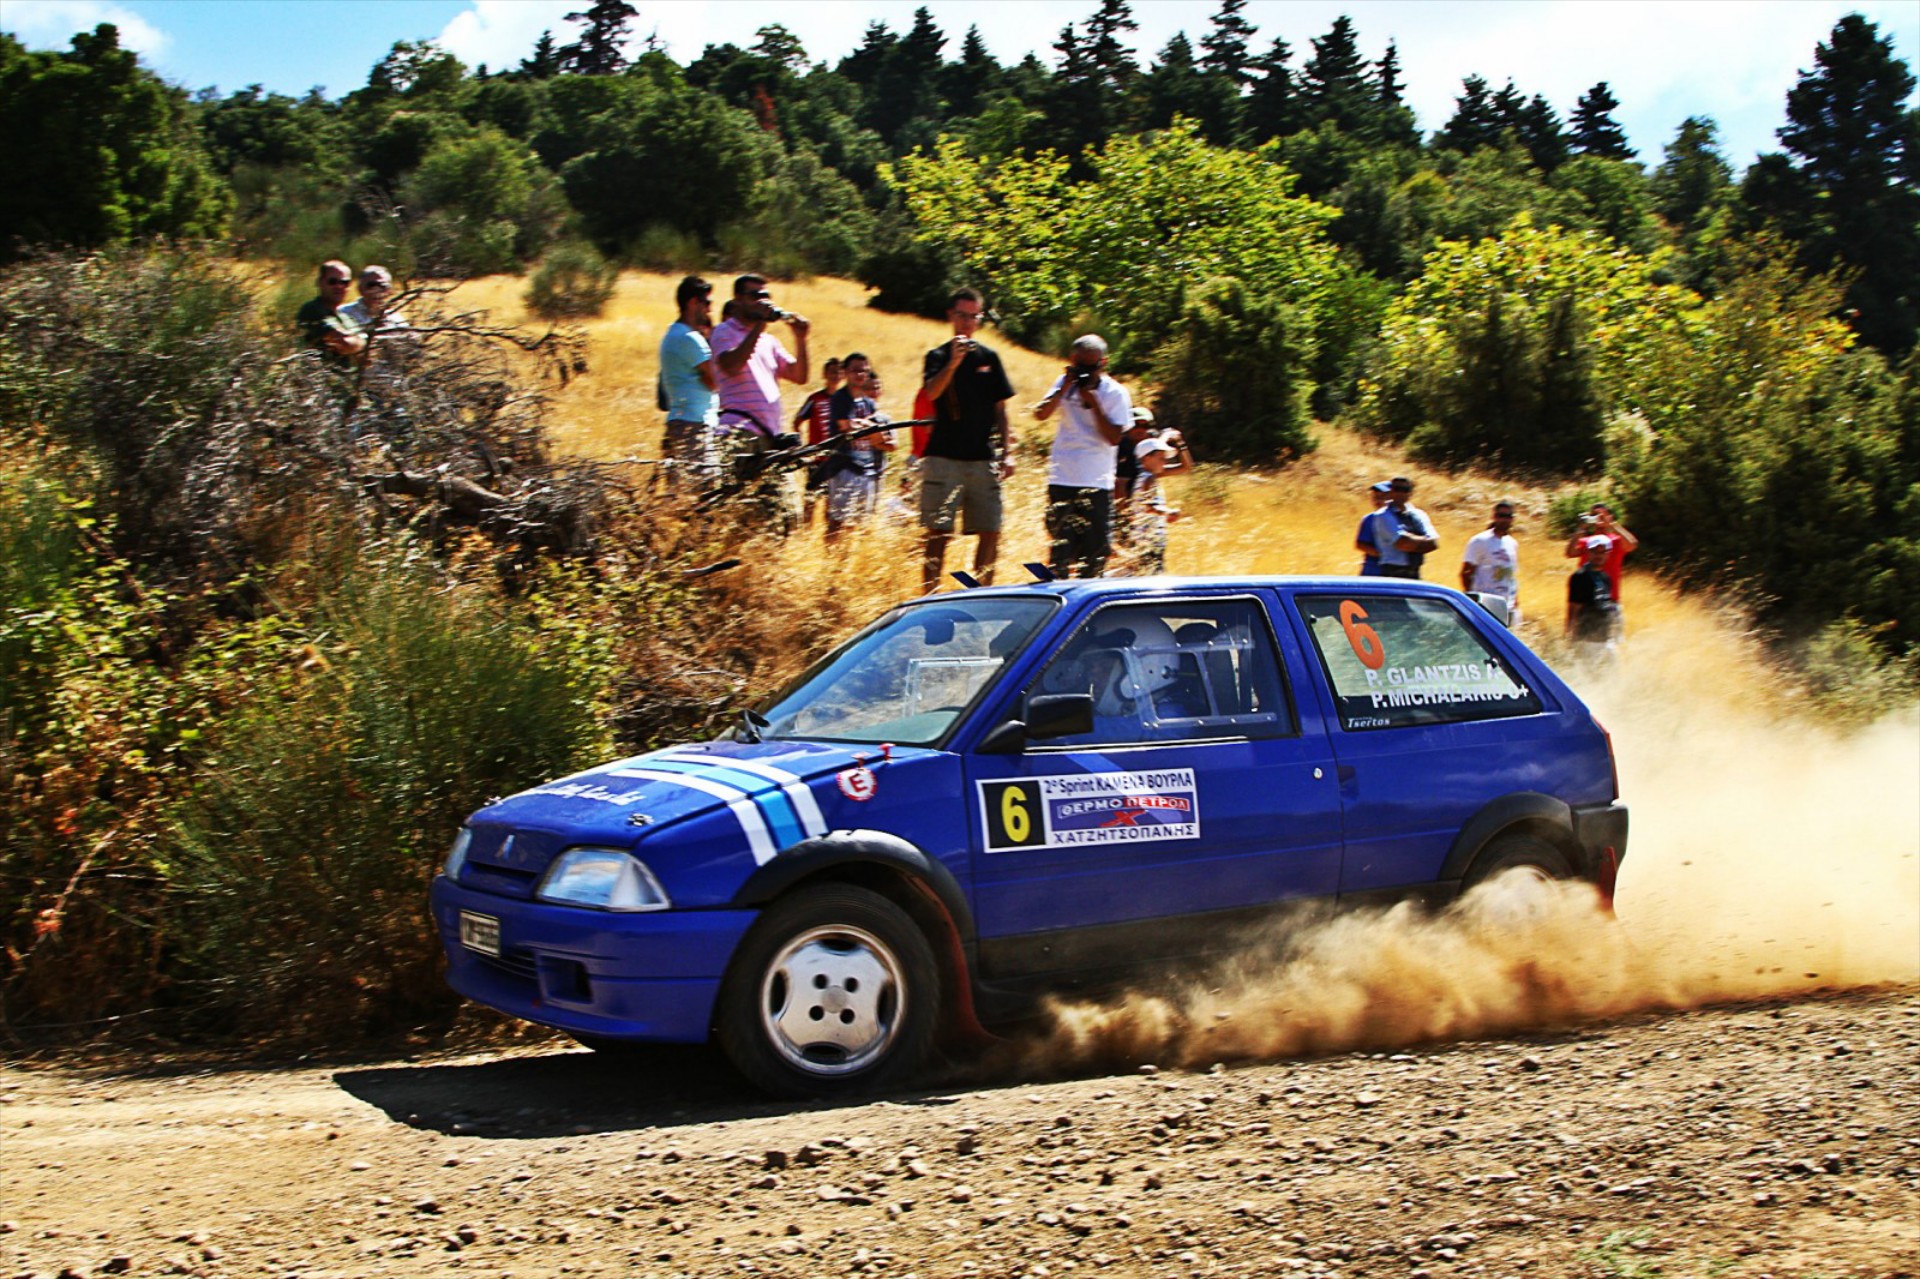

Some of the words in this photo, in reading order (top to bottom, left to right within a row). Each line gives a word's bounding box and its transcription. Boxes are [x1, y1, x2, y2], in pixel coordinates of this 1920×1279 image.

[1339, 600, 1385, 670] 6
[1387, 663, 1482, 685] GLANTZIS
[849, 773, 868, 792] E
[1060, 778, 1094, 796] Sprint
[1002, 785, 1031, 842] 6
[1055, 824, 1194, 844] ΧΑΤΖΗΤΣΟΠΑΝΗΣ
